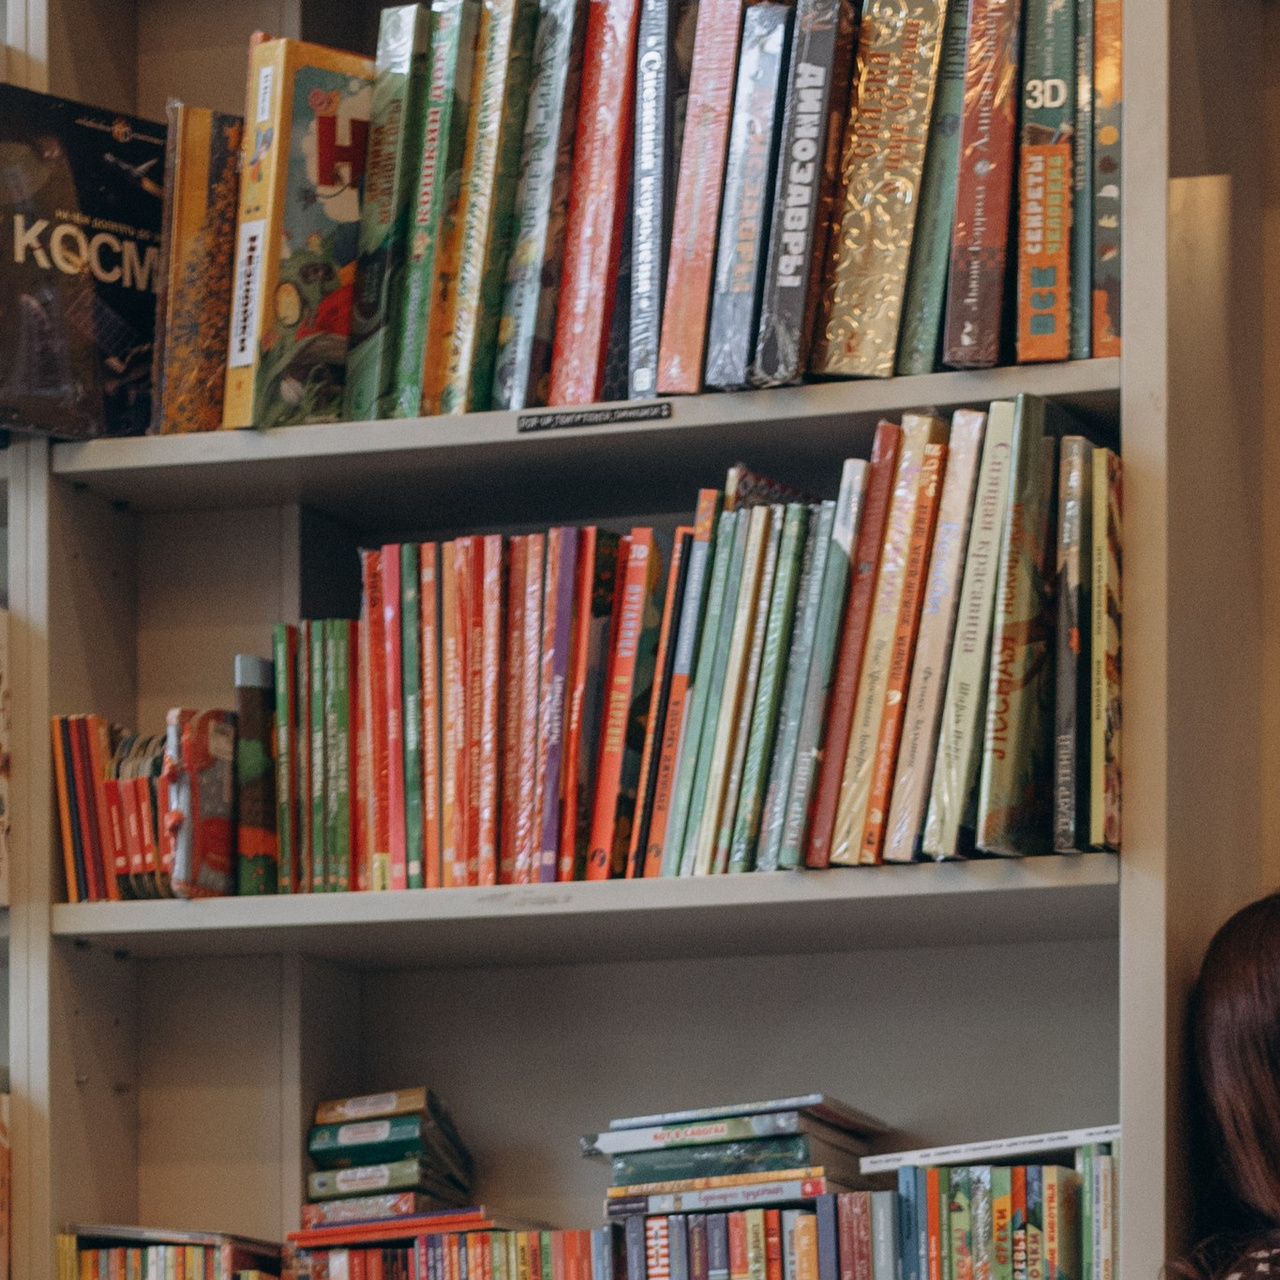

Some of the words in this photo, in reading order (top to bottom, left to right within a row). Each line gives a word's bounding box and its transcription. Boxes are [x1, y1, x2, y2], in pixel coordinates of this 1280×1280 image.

[533, 32, 560, 109] ИВАХ
[1023, 78, 1067, 110] 3D
[383, 97, 403, 146] ГОРЫ
[414, 107, 442, 225] КОШКИН
[428, 42, 449, 101] ДОМ
[533, 120, 549, 137] В
[636, 51, 662, 169] Снежная
[519, 154, 545, 229] ВЕТЕР
[775, 60, 827, 289] ДИНОЗАВРЫ
[1021, 153, 1047, 254] СЕКРЕТЫ
[1043, 154, 1065, 255] ЧЕЛОВЕКА
[13, 215, 163, 295] КОСМ
[633, 176, 657, 294] королева
[975, 439, 1011, 533] Спящая
[922, 519, 960, 616] Бемби
[956, 536, 995, 654] красавица
[617, 583, 644, 659] ПУТАНИЦА
[603, 690, 628, 754] ДЕРЕВНЕ
[1057, 733, 1072, 782] ТЕНЕЙ
[790, 748, 813, 800] ТЕНЕЙ
[1056, 786, 1071, 831] ТЕАТР
[783, 801, 805, 848] ТЕАТР
[994, 1208, 1007, 1264] ОРЕХИ
[1046, 1182, 1057, 1243] ЖИВОТНЫЕ
